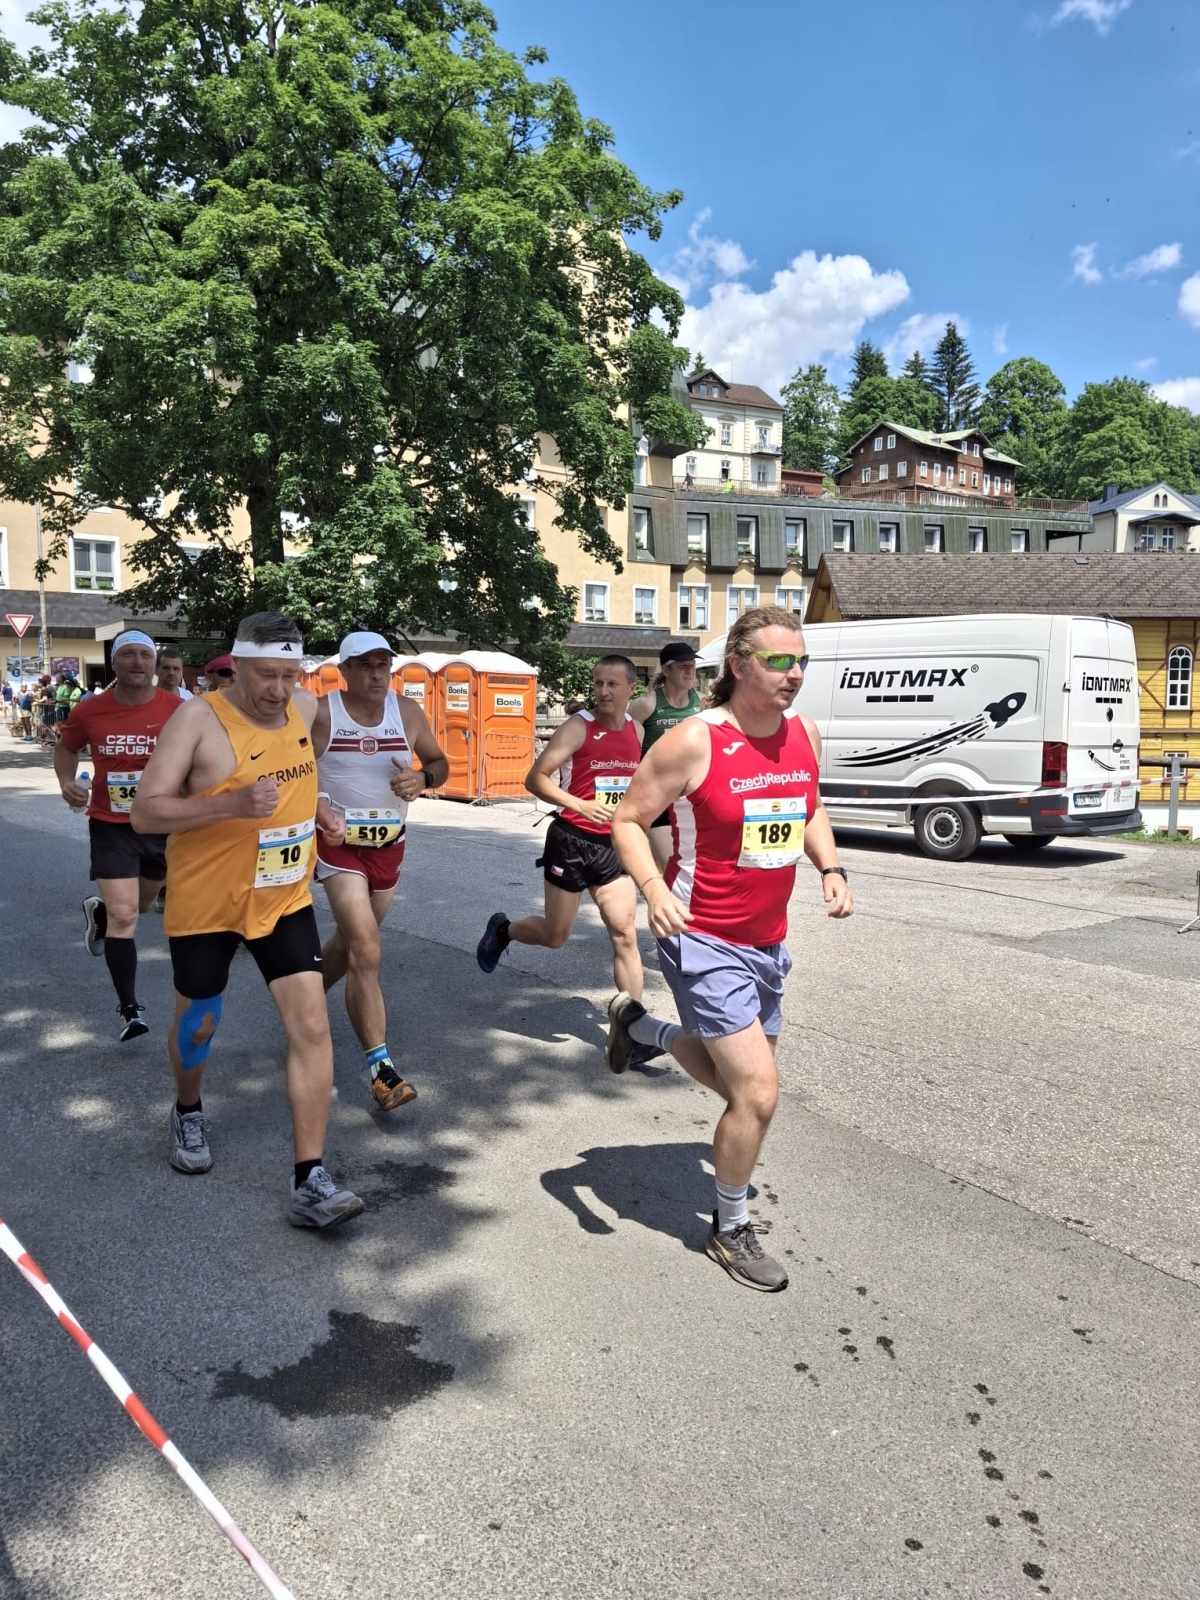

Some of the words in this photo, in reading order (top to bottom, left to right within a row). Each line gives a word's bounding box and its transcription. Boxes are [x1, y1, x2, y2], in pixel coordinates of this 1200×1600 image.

[405, 689, 424, 697] Boels
[448, 686, 468, 695] Boels
[496, 698, 522, 706] Boels
[657, 718, 678, 726] IREL
[384, 728, 399, 736] POL
[106, 734, 157, 746] CZECH
[98, 745, 153, 755] REPUBL
[729, 769, 811, 792] CzechRepublic
[358, 826, 389, 841] 519
[758, 822, 792, 844] 189
[280, 844, 301, 865] 10
